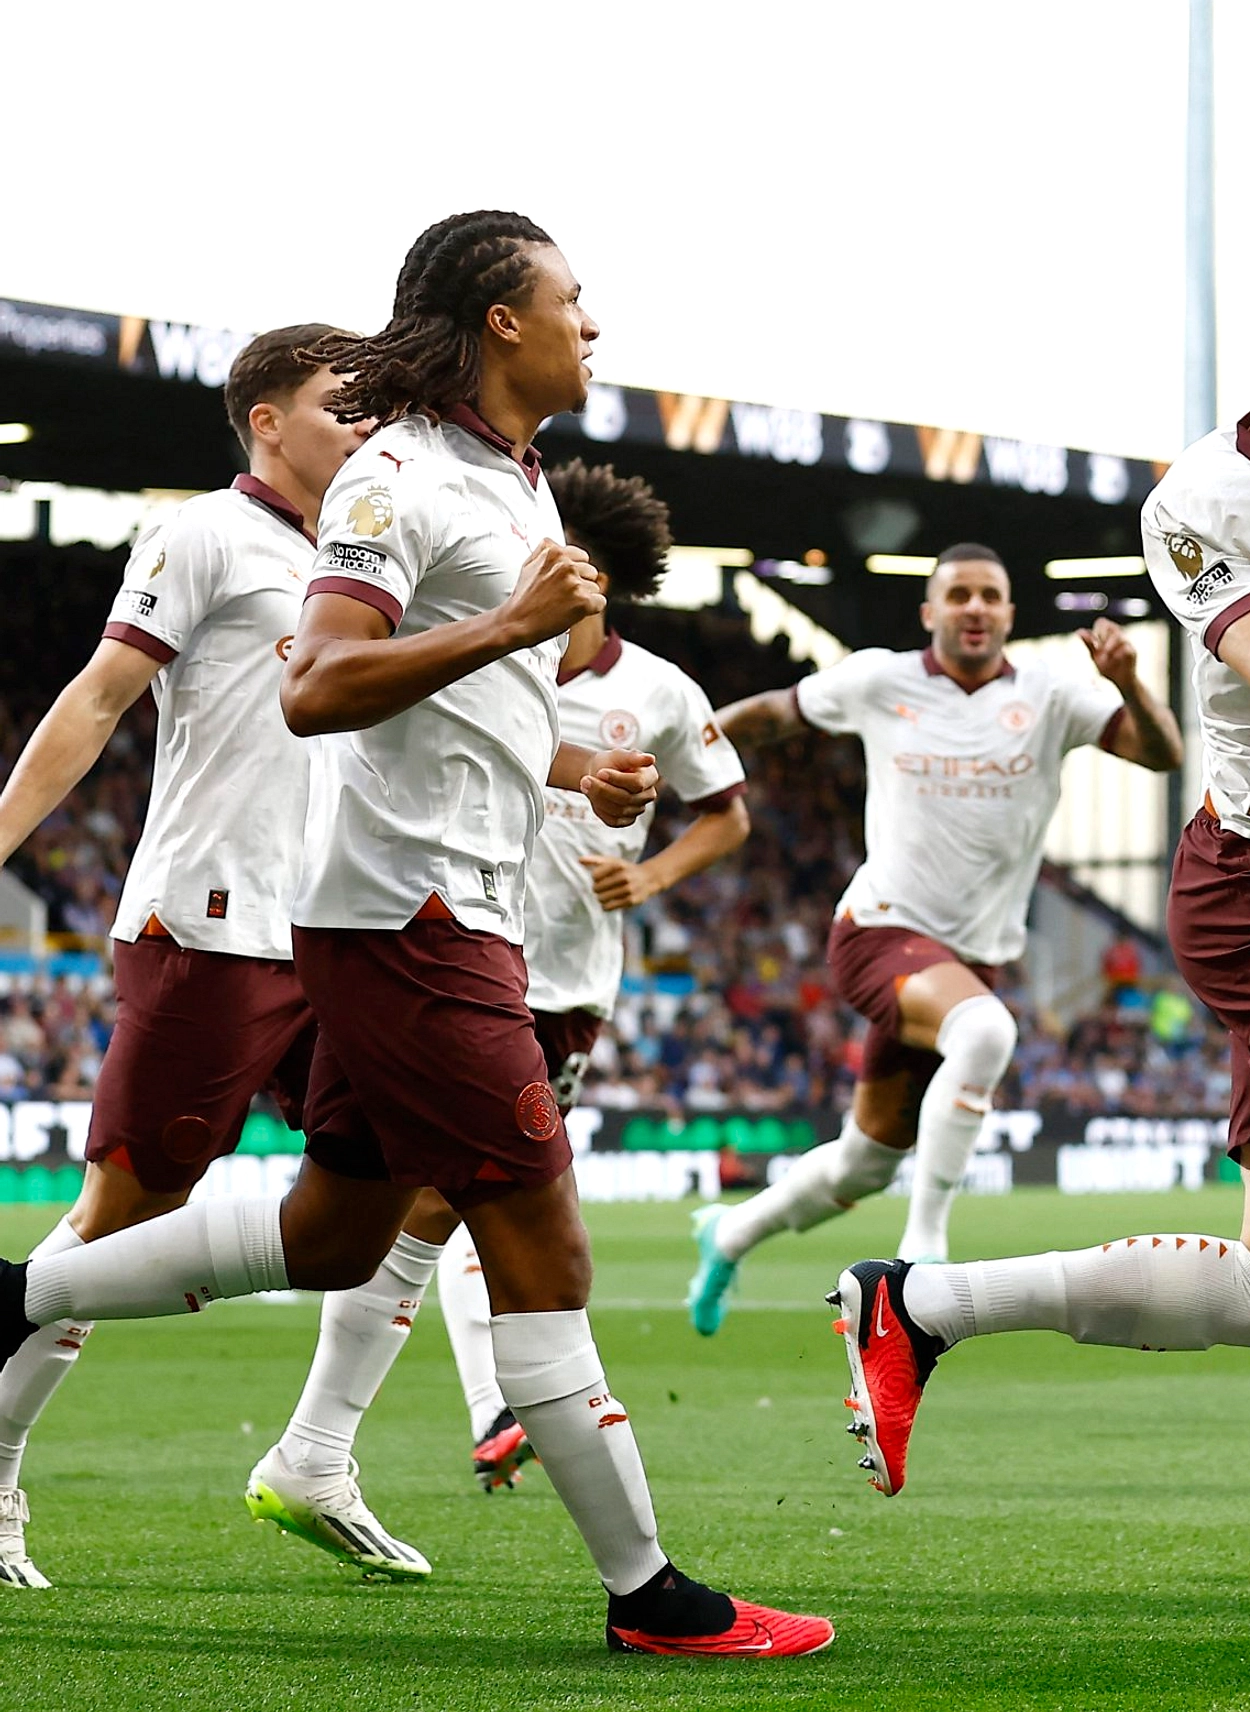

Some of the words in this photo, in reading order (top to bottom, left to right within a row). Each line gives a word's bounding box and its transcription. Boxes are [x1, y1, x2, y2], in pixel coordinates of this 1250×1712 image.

[345, 547, 381, 563] room
[345, 558, 385, 574] racism
[1196, 567, 1224, 595] room
